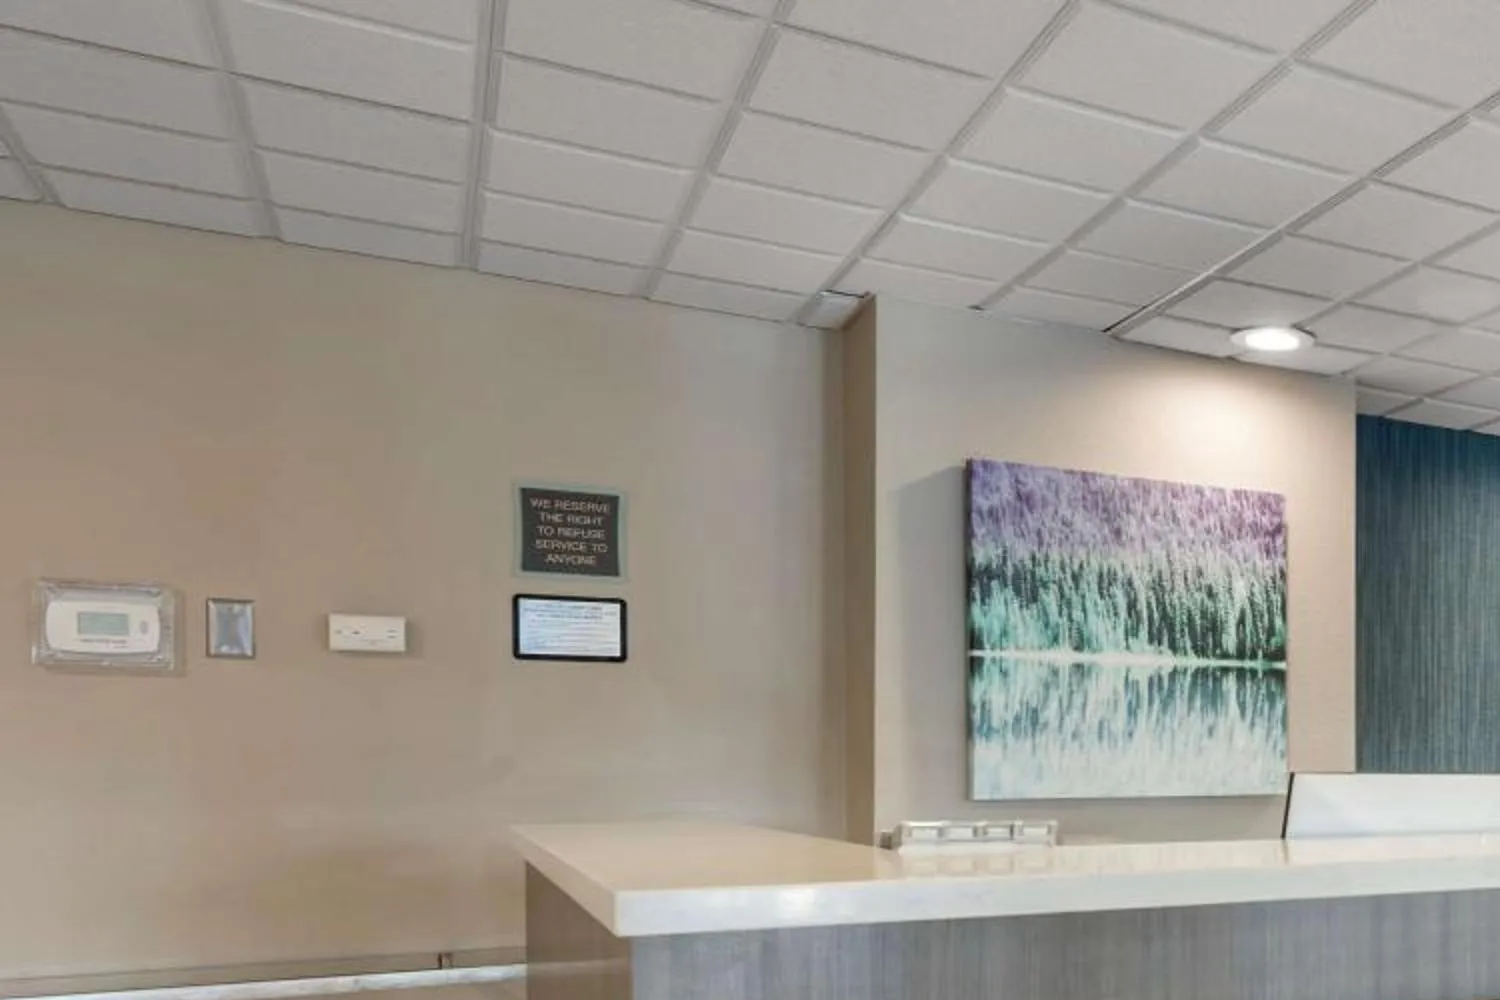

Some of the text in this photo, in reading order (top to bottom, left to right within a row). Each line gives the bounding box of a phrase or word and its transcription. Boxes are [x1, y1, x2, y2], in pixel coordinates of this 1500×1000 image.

[531, 498, 609, 513] WE RESERVE
[540, 512, 604, 525] THE RIGHT
[537, 526, 605, 538] TO REFUSE
[535, 540, 608, 553] SERVICE TO
[545, 554, 596, 565] ANYONE
